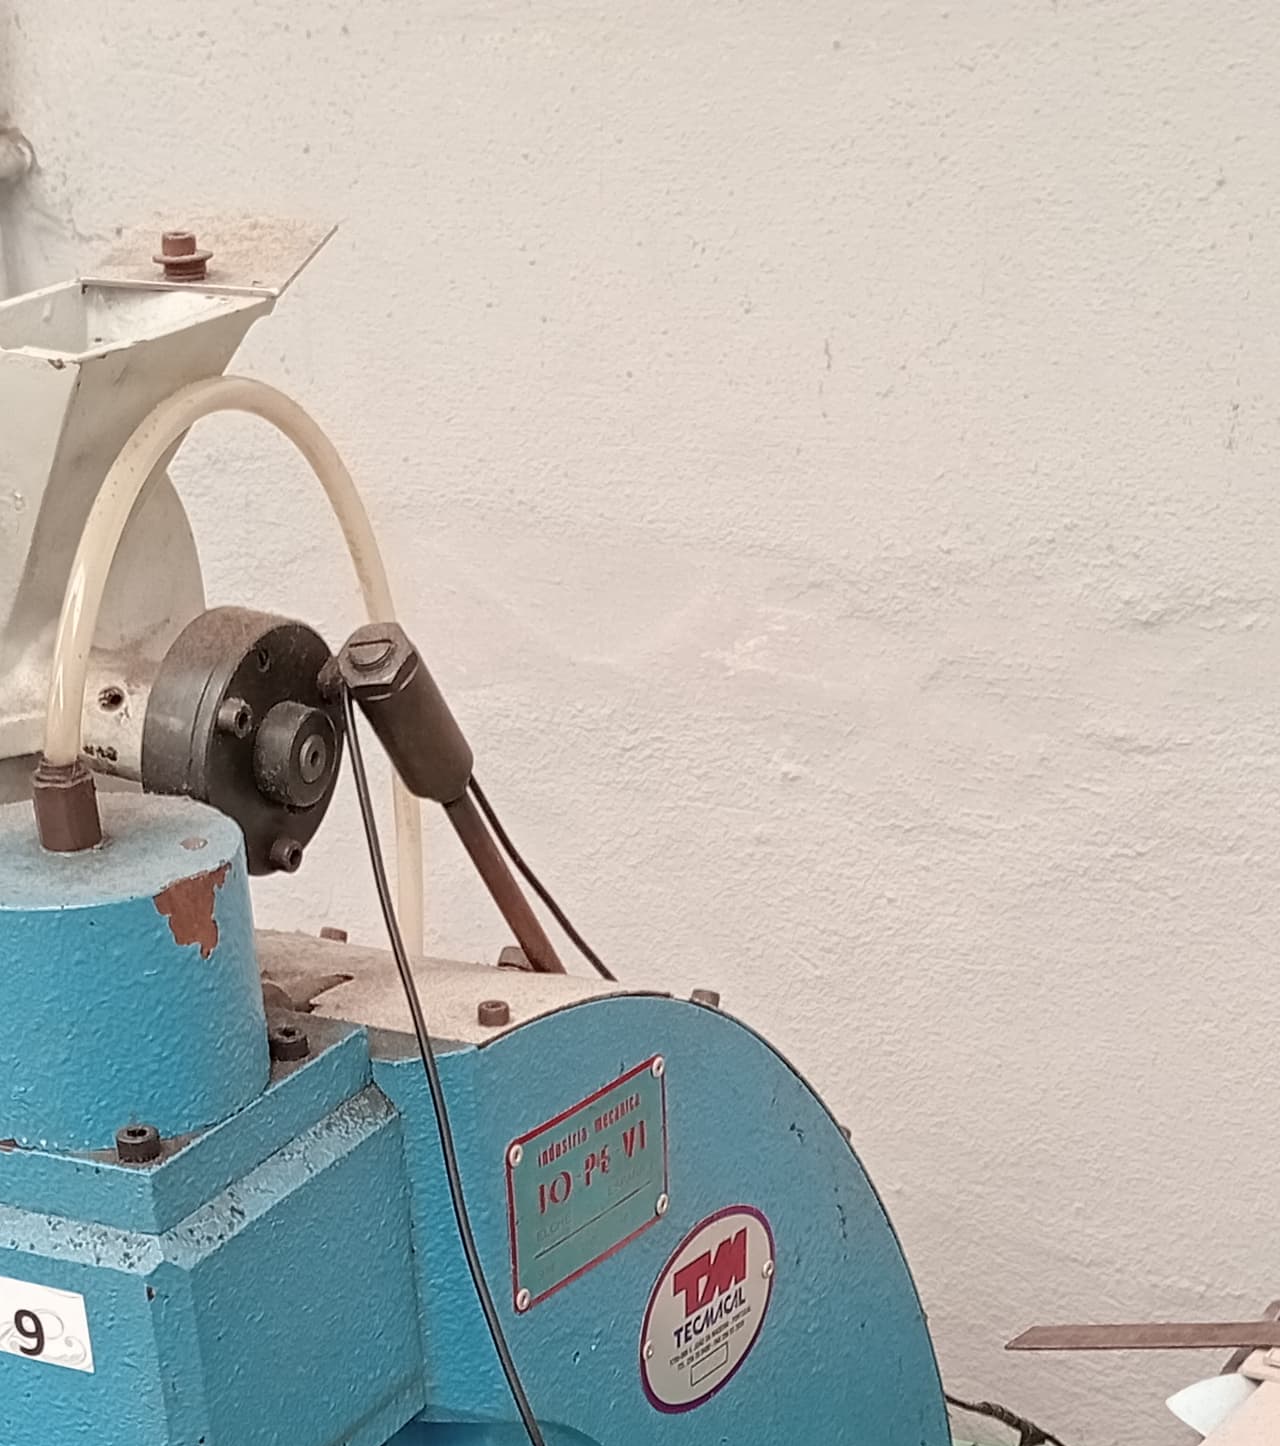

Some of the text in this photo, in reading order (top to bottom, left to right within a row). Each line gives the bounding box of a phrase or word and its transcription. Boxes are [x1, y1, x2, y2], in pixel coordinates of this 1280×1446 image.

[673, 1227, 747, 1318] TM
[14, 1308, 45, 1357] 9
[673, 1286, 747, 1349] TECMACAL
